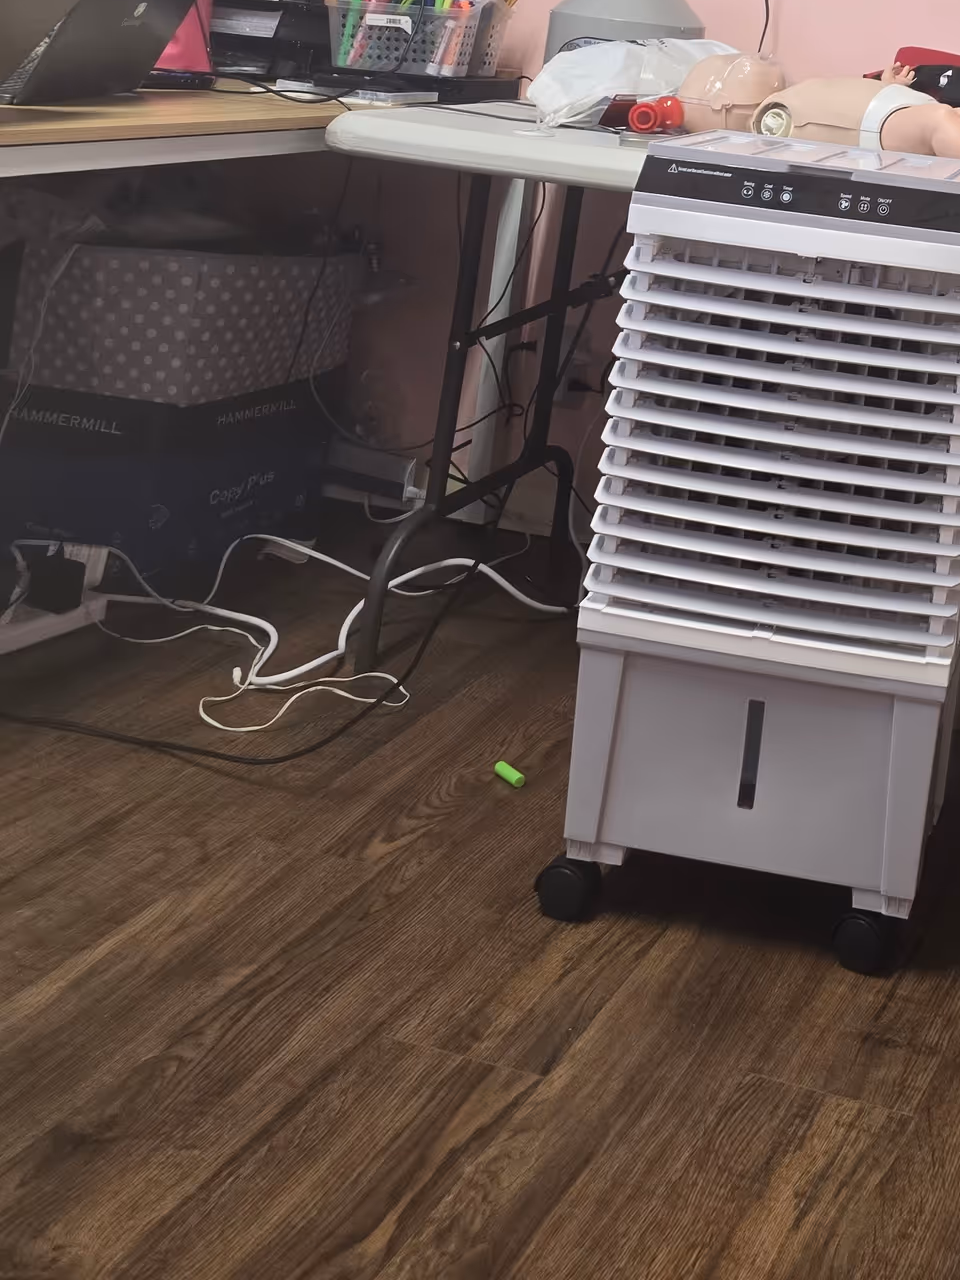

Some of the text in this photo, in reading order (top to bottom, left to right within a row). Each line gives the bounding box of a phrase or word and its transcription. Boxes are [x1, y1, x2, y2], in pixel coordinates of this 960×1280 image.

[10, 407, 124, 435] HAMMERMILL
[216, 400, 297, 426] HAMMERMILL
[209, 482, 245, 506] Copy
